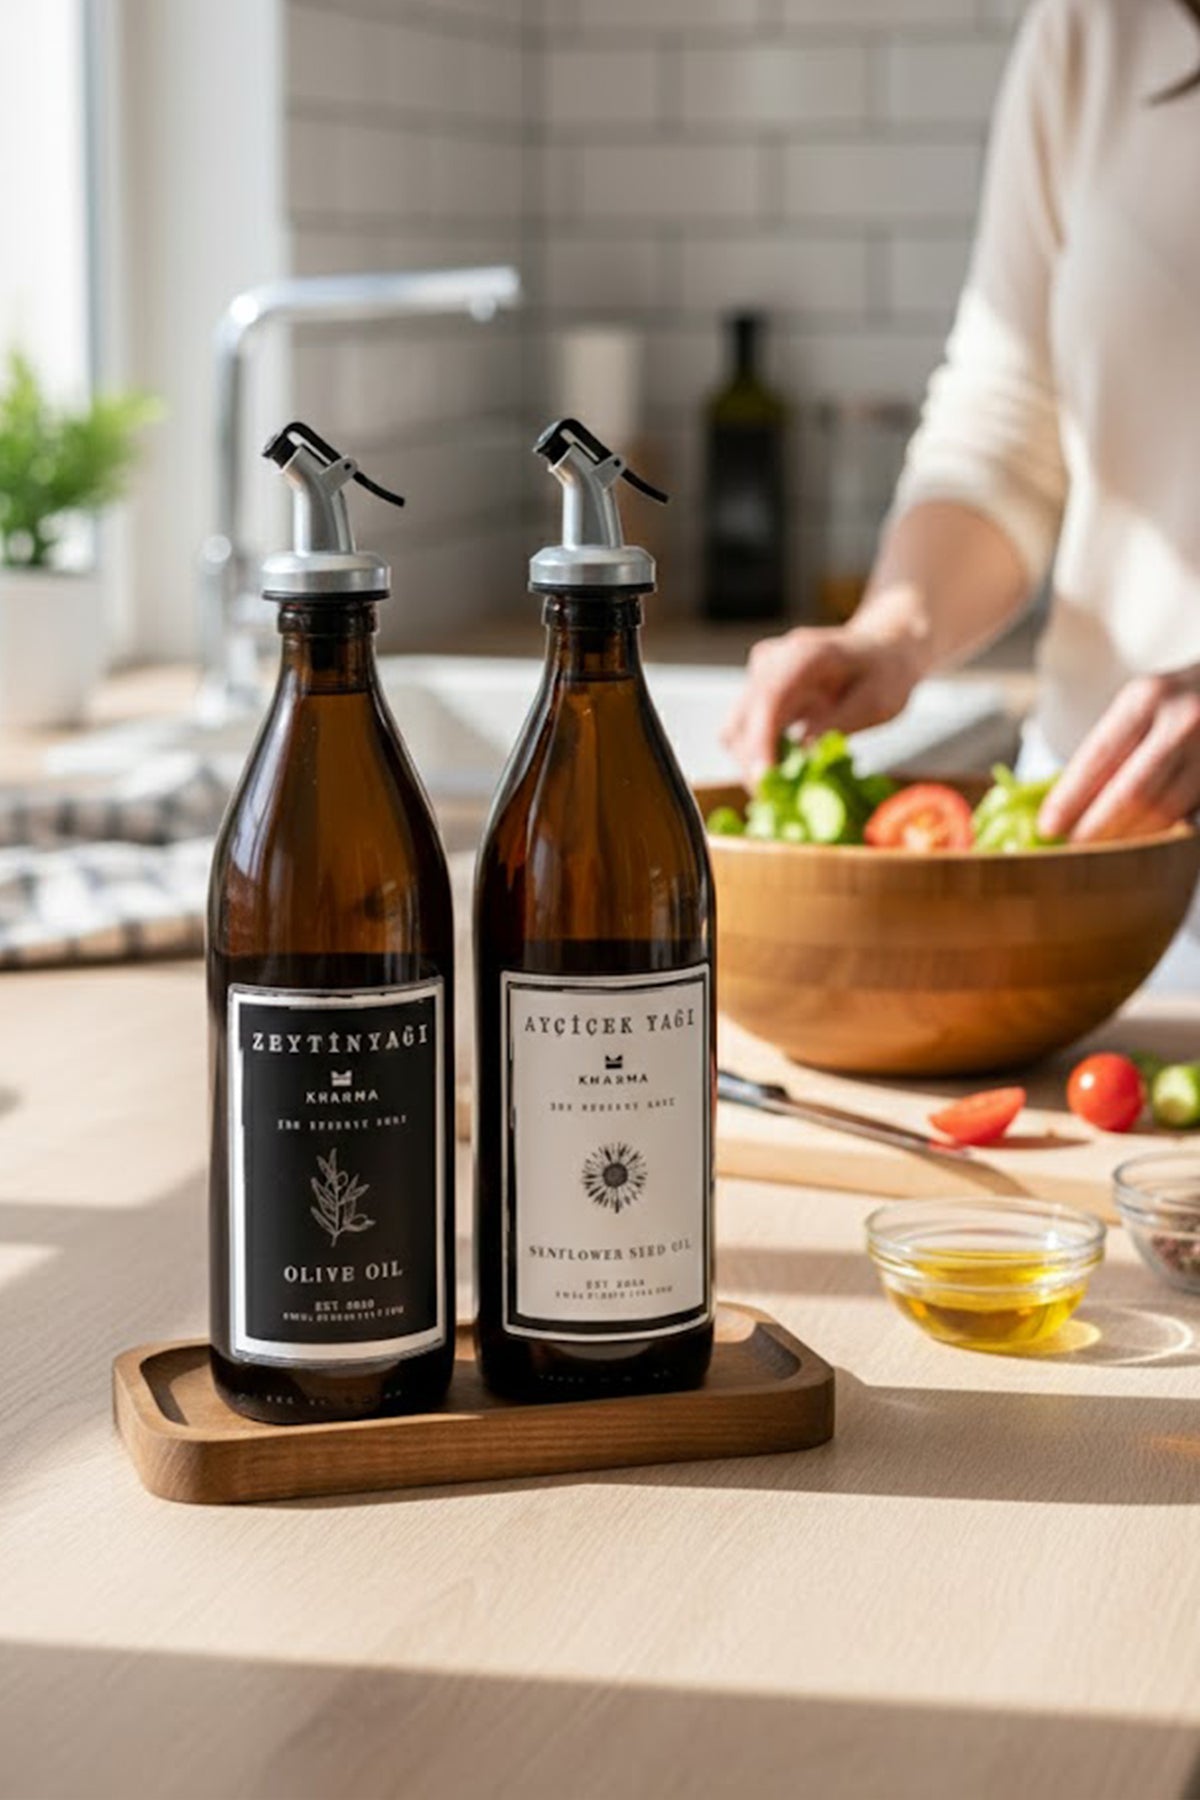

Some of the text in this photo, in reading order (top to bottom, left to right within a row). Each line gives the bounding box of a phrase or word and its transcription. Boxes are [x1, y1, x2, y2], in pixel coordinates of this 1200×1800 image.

[525, 1014, 632, 1037] AYÇİÇEK
[578, 1073, 649, 1085] KHARMA
[283, 1260, 403, 1283] OLIVE OIL
